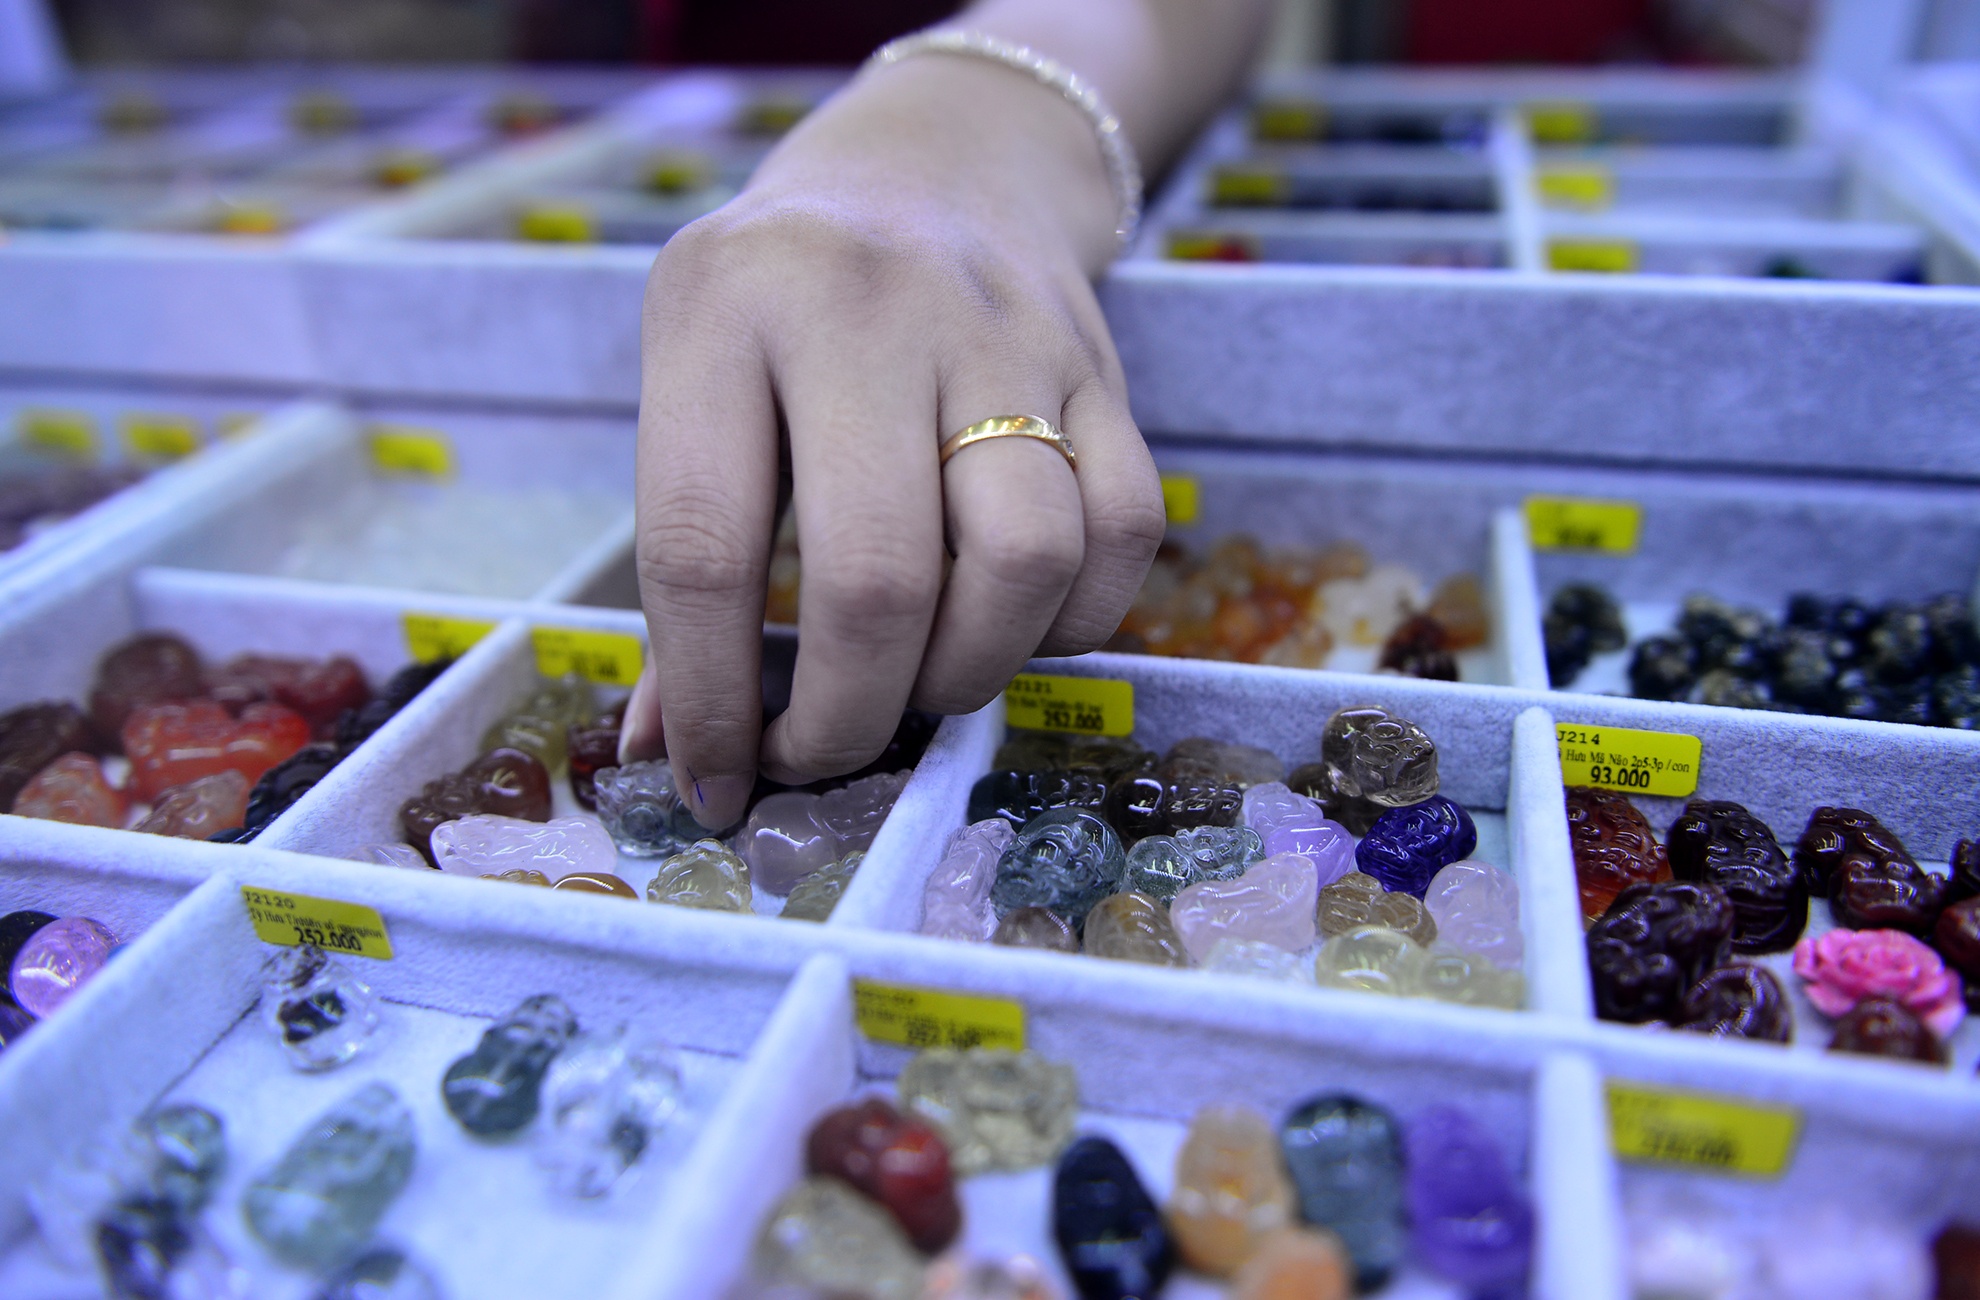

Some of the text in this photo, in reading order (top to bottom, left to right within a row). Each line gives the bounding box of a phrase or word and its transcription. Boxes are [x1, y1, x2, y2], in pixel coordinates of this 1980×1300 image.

[1556, 730, 1600, 745] J214
[1590, 765, 1650, 788] 93.000
[293, 927, 362, 951] 252.000
